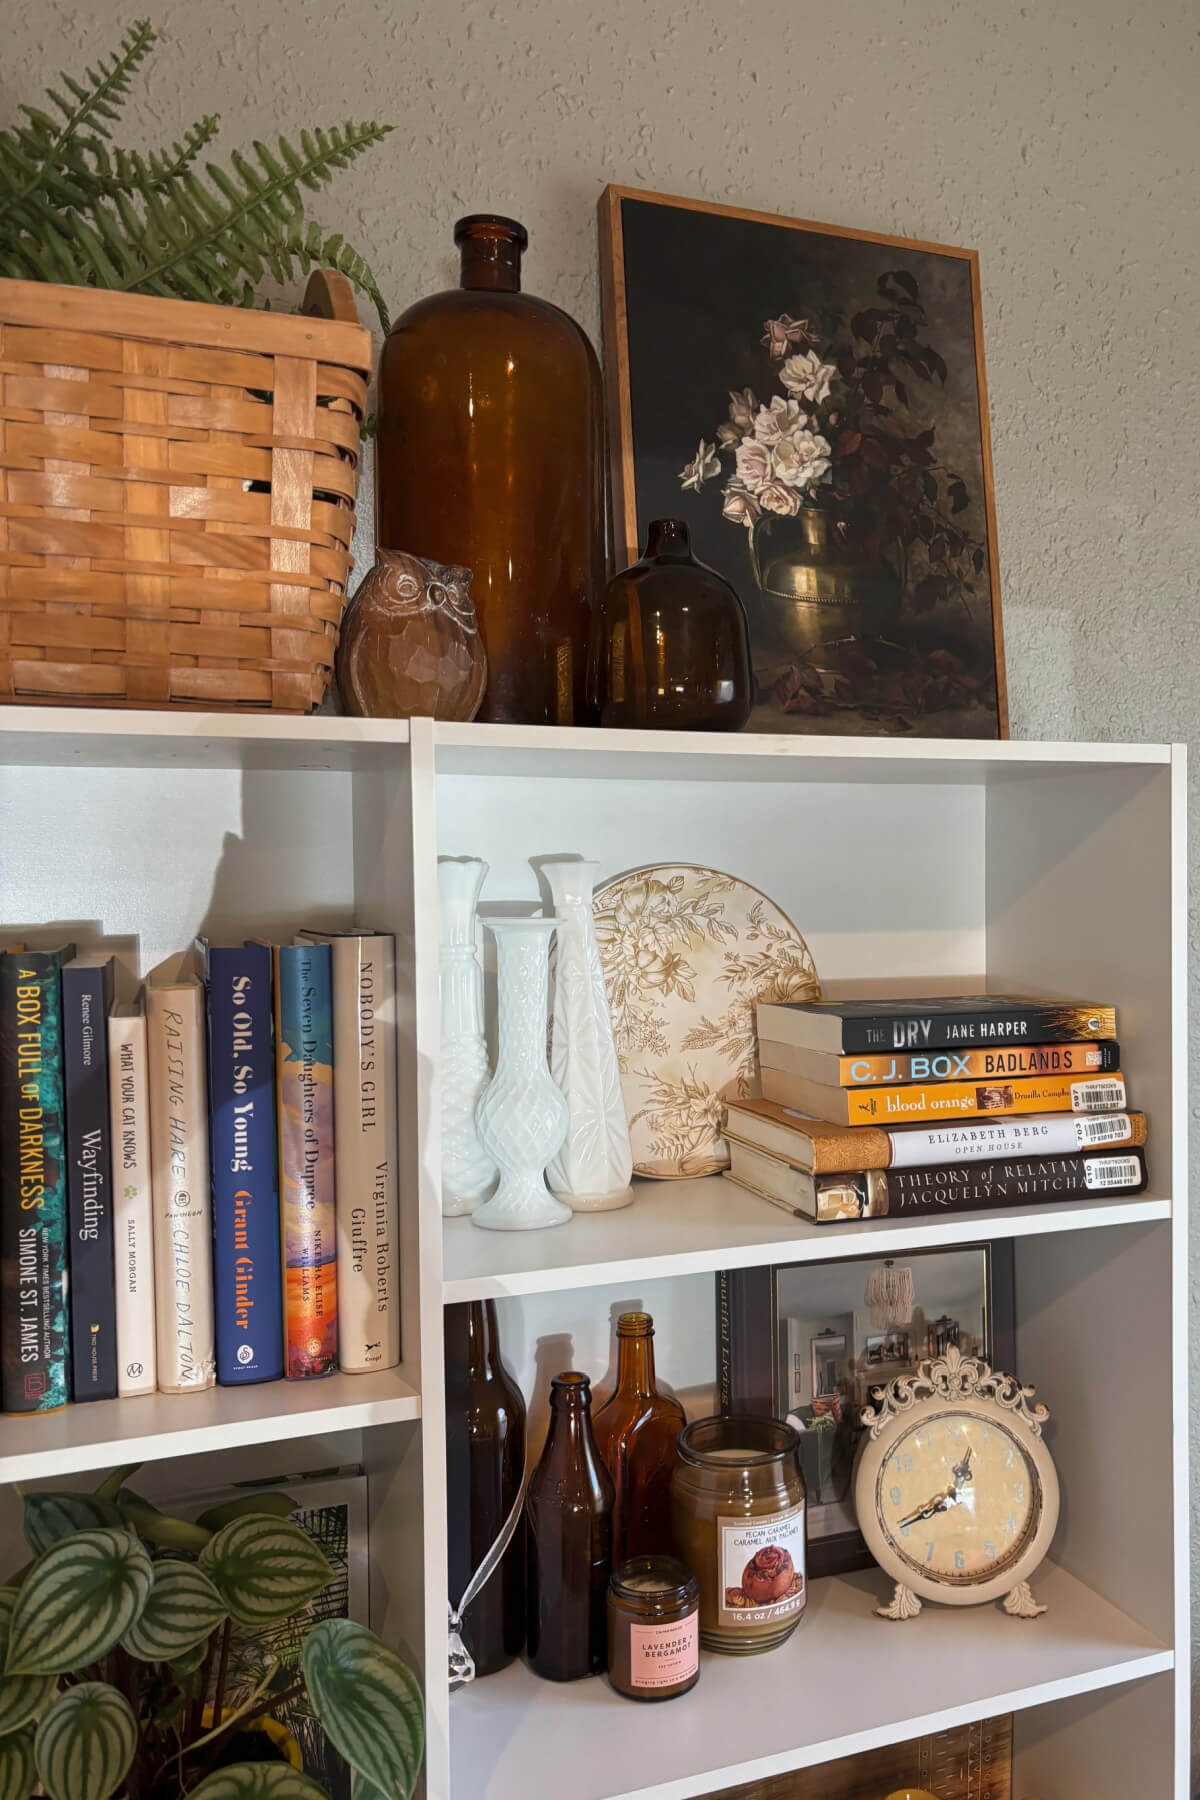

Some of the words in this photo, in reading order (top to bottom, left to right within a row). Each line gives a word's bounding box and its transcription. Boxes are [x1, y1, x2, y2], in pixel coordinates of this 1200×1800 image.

[18, 969, 37, 980] A
[300, 959, 313, 982] The
[231, 975, 253, 1005] So
[16, 986, 41, 1026] BOX
[81, 994, 93, 1024] Renee
[302, 986, 317, 1034] Seven
[359, 961, 375, 1072] NOBODY'S
[82, 1026, 94, 1066] Gilmore
[866, 1029, 886, 1043] THE
[893, 1019, 932, 1048] DRY
[946, 1024, 975, 1040] JANE
[980, 1021, 1028, 1037] HARPER
[17, 1033, 42, 1078] FULL
[119, 1043, 134, 1072] WHAT
[162, 1009, 185, 1106] RAISING
[911, 1055, 972, 1079] BOX
[985, 1050, 1073, 1073] BADLANDS
[20, 1083, 40, 1102] OF
[120, 1076, 135, 1103] YOUR
[233, 1065, 254, 1095] So
[297, 1040, 318, 1123] Daughters
[121, 1108, 136, 1126] CAT
[360, 1081, 376, 1133] GIRL
[886, 1094, 927, 1113] blood
[930, 1095, 975, 1111] orange
[230, 1101, 255, 1173] Young
[304, 1128, 319, 1145] of
[928, 1128, 1006, 1144] ELIZABETH
[1014, 1125, 1050, 1137] BERG
[1075, 1123, 1083, 1141] 703
[18, 1108, 45, 1210] DARKNESS
[122, 1131, 137, 1169] KNOWS
[168, 1116, 187, 1180] HARE
[955, 1144, 983, 1154] OPEN
[988, 1142, 1024, 1151] HOUSE
[77, 1128, 104, 1241] Wayfinding
[300, 1149, 319, 1210] Dupree
[877, 1179, 887, 1190] A
[895, 1169, 971, 1188] THEORY
[981, 1165, 995, 1184] of
[1005, 1159, 1084, 1179] RELATIV
[372, 1161, 388, 1242] Virginia
[899, 1182, 1008, 1208] JACQUELYN
[1017, 1176, 1087, 1194] MITCHA
[127, 1219, 136, 1248] SALLY
[233, 1190, 253, 1250] Grant
[41, 1228, 49, 1243] NEW
[350, 1208, 367, 1273] Giuffre
[18, 1228, 38, 1285] SIMONE
[41, 1245, 49, 1262] YORK
[172, 1230, 191, 1293] CHLOE
[314, 1230, 323, 1280] NIKESHA
[42, 1264, 50, 1285] TIMES
[128, 1251, 137, 1293] MORGAN
[301, 1248, 311, 1302] WILLIAMS
[375, 1243, 390, 1313] Roberts
[19, 1290, 38, 1312] ST.
[42, 1286, 50, 1330] BESTSELLING
[234, 1257, 255, 1330] Ginder
[316, 1286, 324, 1317] ELISE
[720, 1271, 729, 1341] eautiful
[20, 1316, 39, 1363] JAMES
[43, 1331, 51, 1359] AUTHOR
[174, 1302, 194, 1382] DALTON
[720, 1348, 730, 1406] Living
[889, 1485, 902, 1505] 9
[1013, 1482, 1024, 1504] 3
[733, 1538, 762, 1546] CARAMEL
[745, 1530, 766, 1538] PECAN
[924, 1541, 935, 1562] 7
[954, 1549, 965, 1570] 6
[983, 1539, 996, 1560] 5
[732, 1613, 751, 1621] 16.4
[642, 1637, 687, 1650] LAVENDER
[645, 1641, 691, 1658] BERGAMOT
